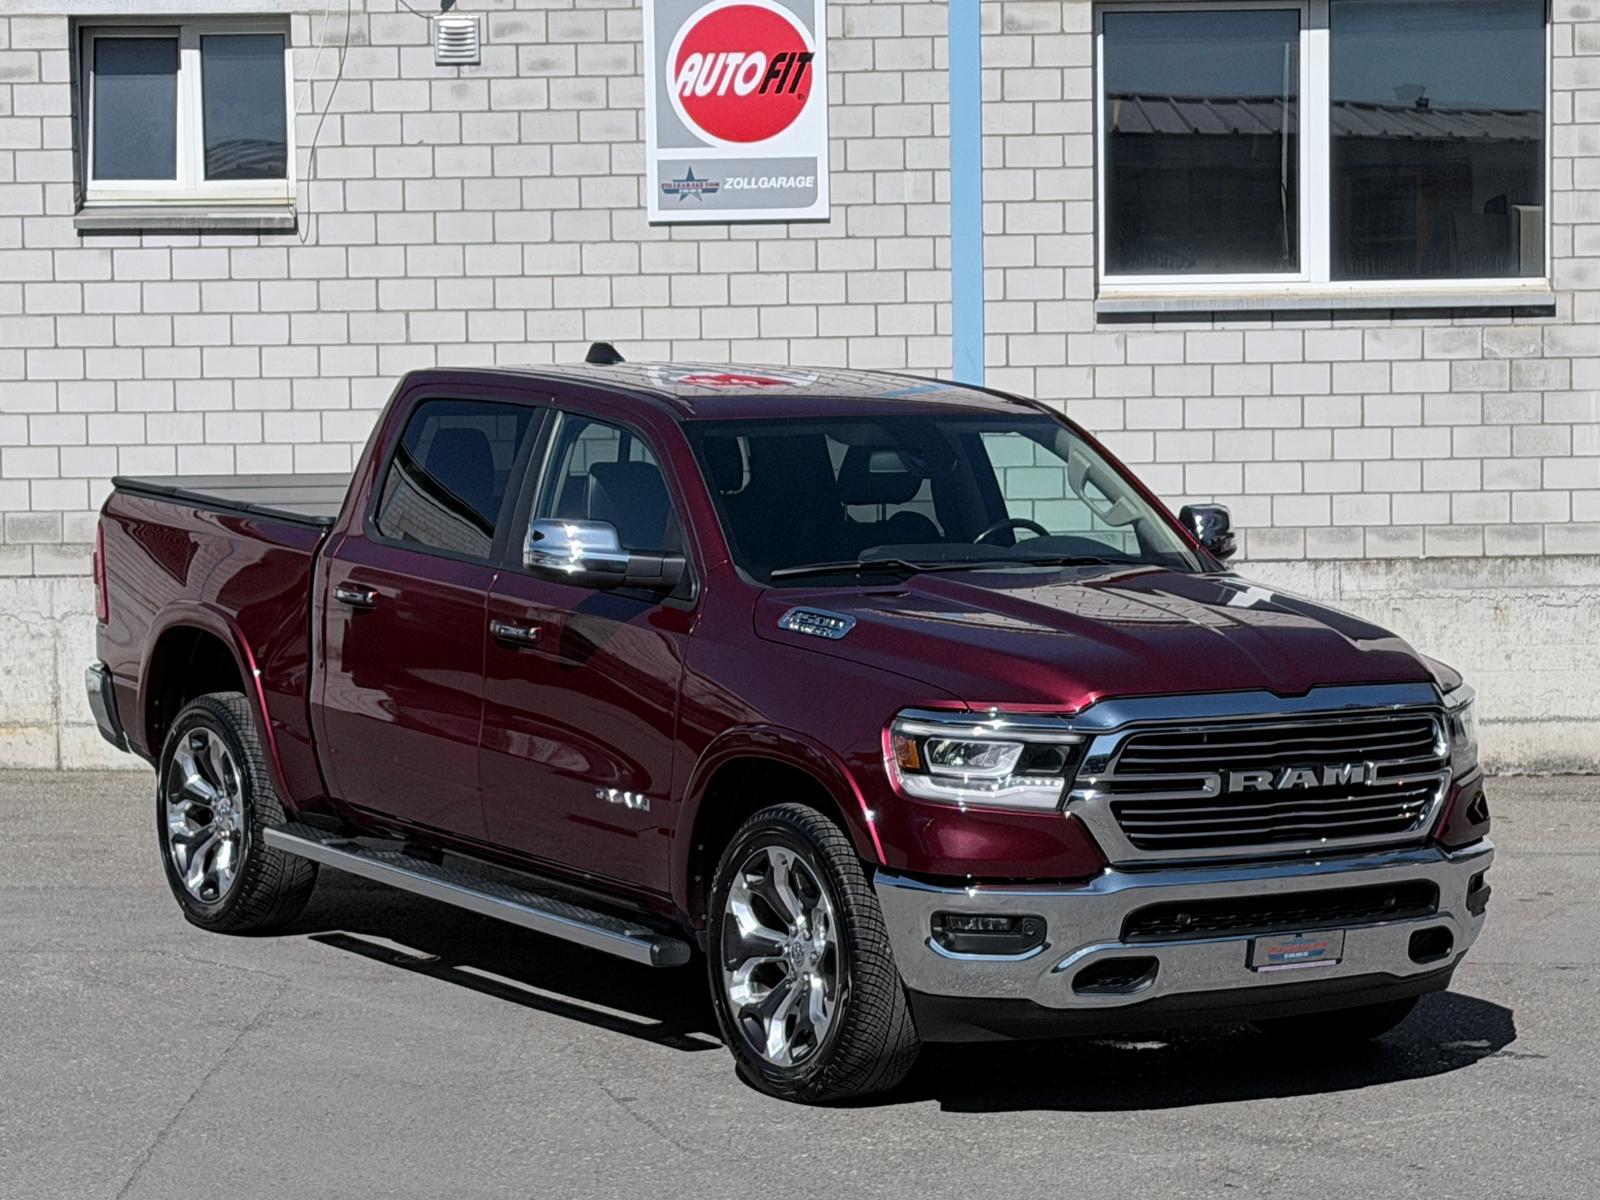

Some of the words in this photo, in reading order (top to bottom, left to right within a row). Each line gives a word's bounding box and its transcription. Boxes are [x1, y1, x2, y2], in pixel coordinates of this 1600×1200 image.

[676, 51, 815, 97] AUTOFIT
[724, 175, 815, 190] ZOLLGARAGE
[1228, 763, 1365, 793] RAM
